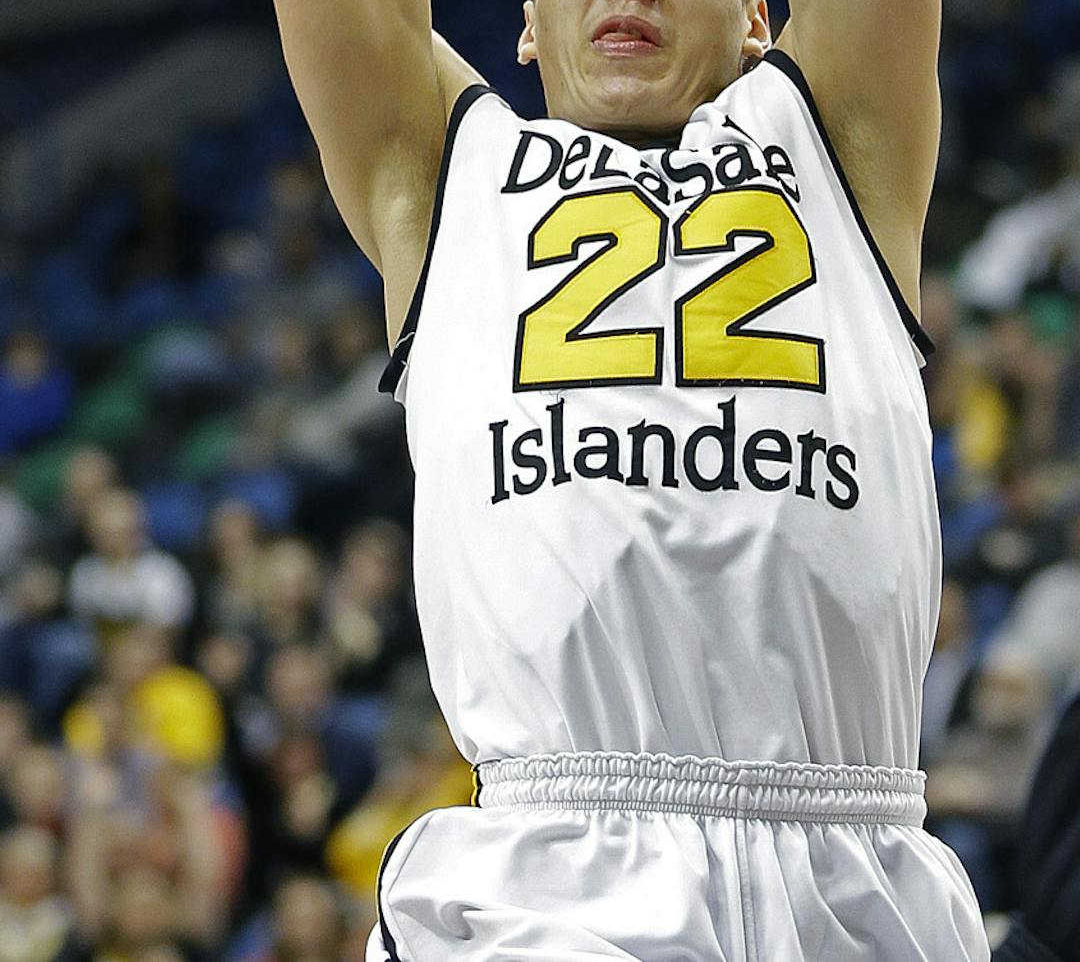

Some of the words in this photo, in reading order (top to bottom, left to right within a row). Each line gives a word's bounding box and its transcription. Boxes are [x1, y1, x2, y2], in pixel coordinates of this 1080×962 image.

[500, 114, 801, 206] DeLaSae
[512, 184, 826, 394] 22
[487, 395, 861, 510] Islanders
